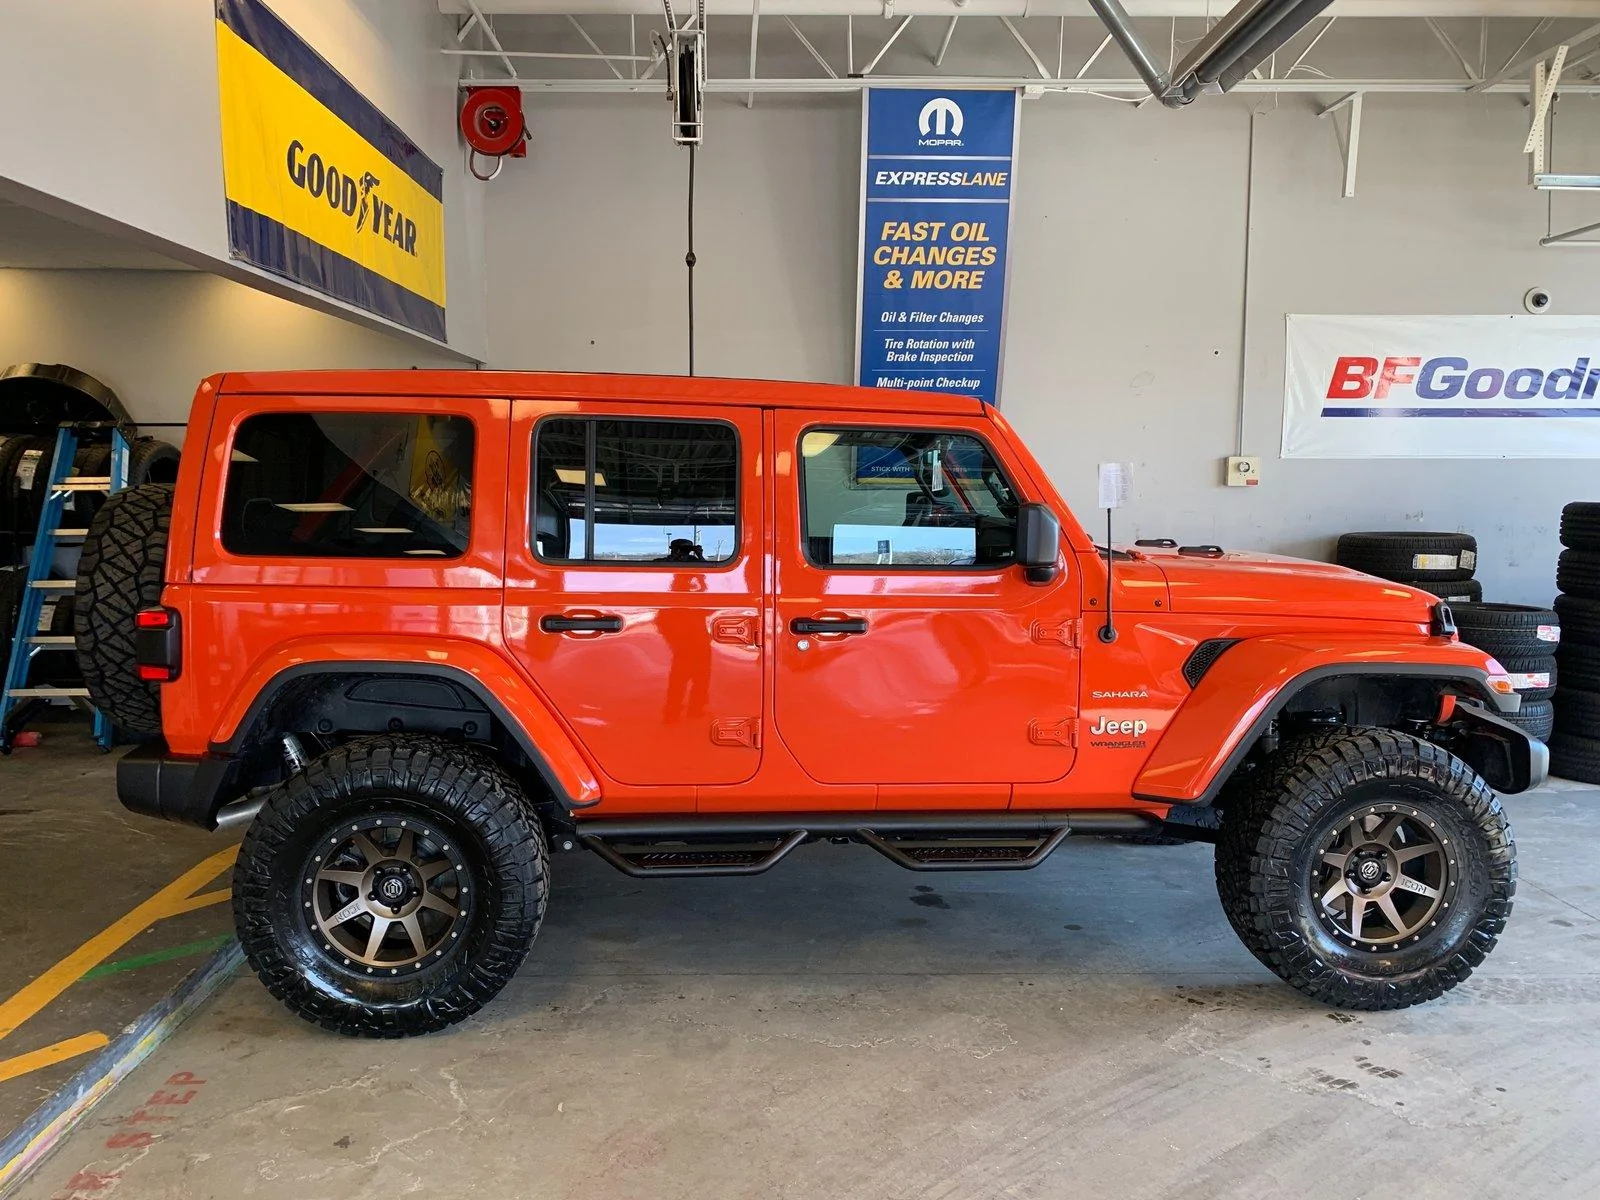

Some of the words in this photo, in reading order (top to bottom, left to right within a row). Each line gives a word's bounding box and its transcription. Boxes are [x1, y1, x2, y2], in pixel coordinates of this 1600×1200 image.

[875, 171, 1008, 186] EXPRESSLANE
[881, 221, 945, 241] FAST
[950, 222, 990, 242] OIL
[873, 245, 997, 266] CHANGES
[883, 269, 903, 289] &
[910, 270, 985, 290] MORE
[880, 311, 896, 323] Oil
[897, 312, 907, 323] &
[909, 312, 938, 323] Filter
[939, 312, 984, 325] Changes
[884, 338, 904, 349] Tire
[906, 338, 949, 349] Rotation
[951, 338, 975, 349] with
[886, 351, 917, 362] Brake
[919, 351, 974, 365] Inspection
[876, 377, 935, 390] Multi-point
[935, 377, 980, 390] Checkup
[1090, 716, 1148, 737] Jeep
[1090, 740, 1146, 748] WRANGLER
